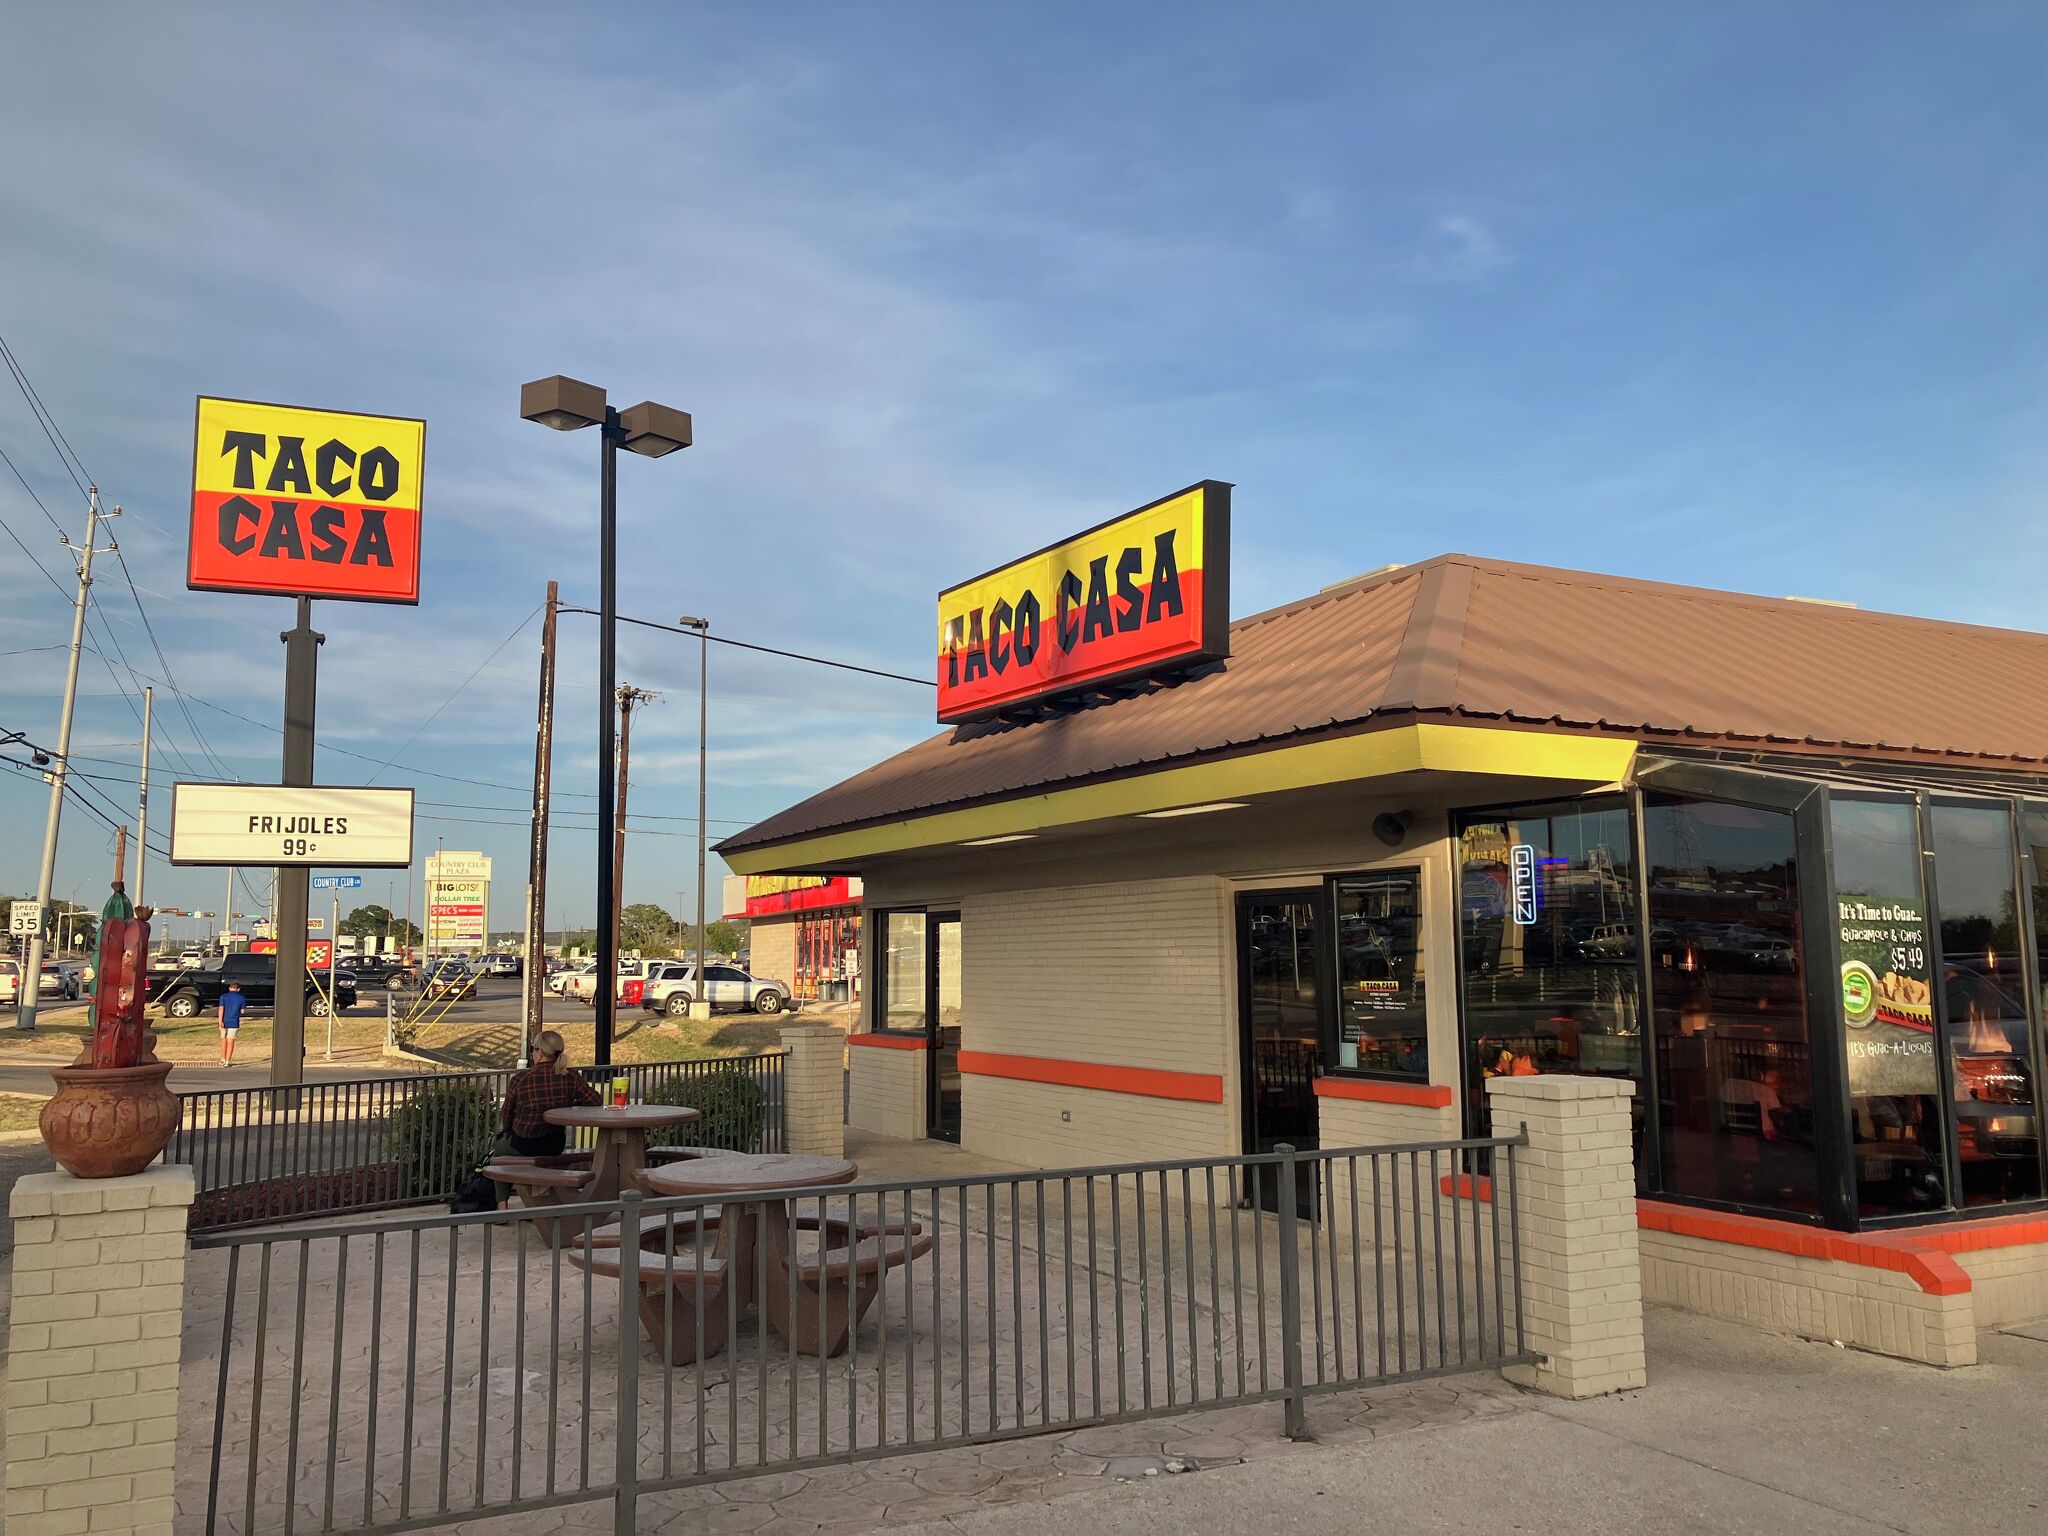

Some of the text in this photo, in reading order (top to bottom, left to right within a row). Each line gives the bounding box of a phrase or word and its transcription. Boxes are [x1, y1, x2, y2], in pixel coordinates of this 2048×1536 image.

[221, 430, 399, 501] TACO
[218, 495, 394, 567] CASA
[943, 529, 1183, 688] TACO CASA
[249, 816, 347, 834] FRIJOLES
[283, 839, 316, 856] 99¢
[314, 878, 338, 887] COUNTRY
[340, 877, 354, 887] CLUB
[436, 883, 455, 891] BIG
[1515, 851, 1532, 920] OPEN
[1839, 902, 1856, 919] It's
[1857, 902, 1880, 921] Time
[1882, 906, 1892, 920] to
[13, 918, 37, 930] 35
[1891, 929, 1898, 942] &
[1891, 947, 1924, 972] $5.49
[1882, 1005, 1932, 1026] TACO CASA
[1850, 1041, 1865, 1058] It's
